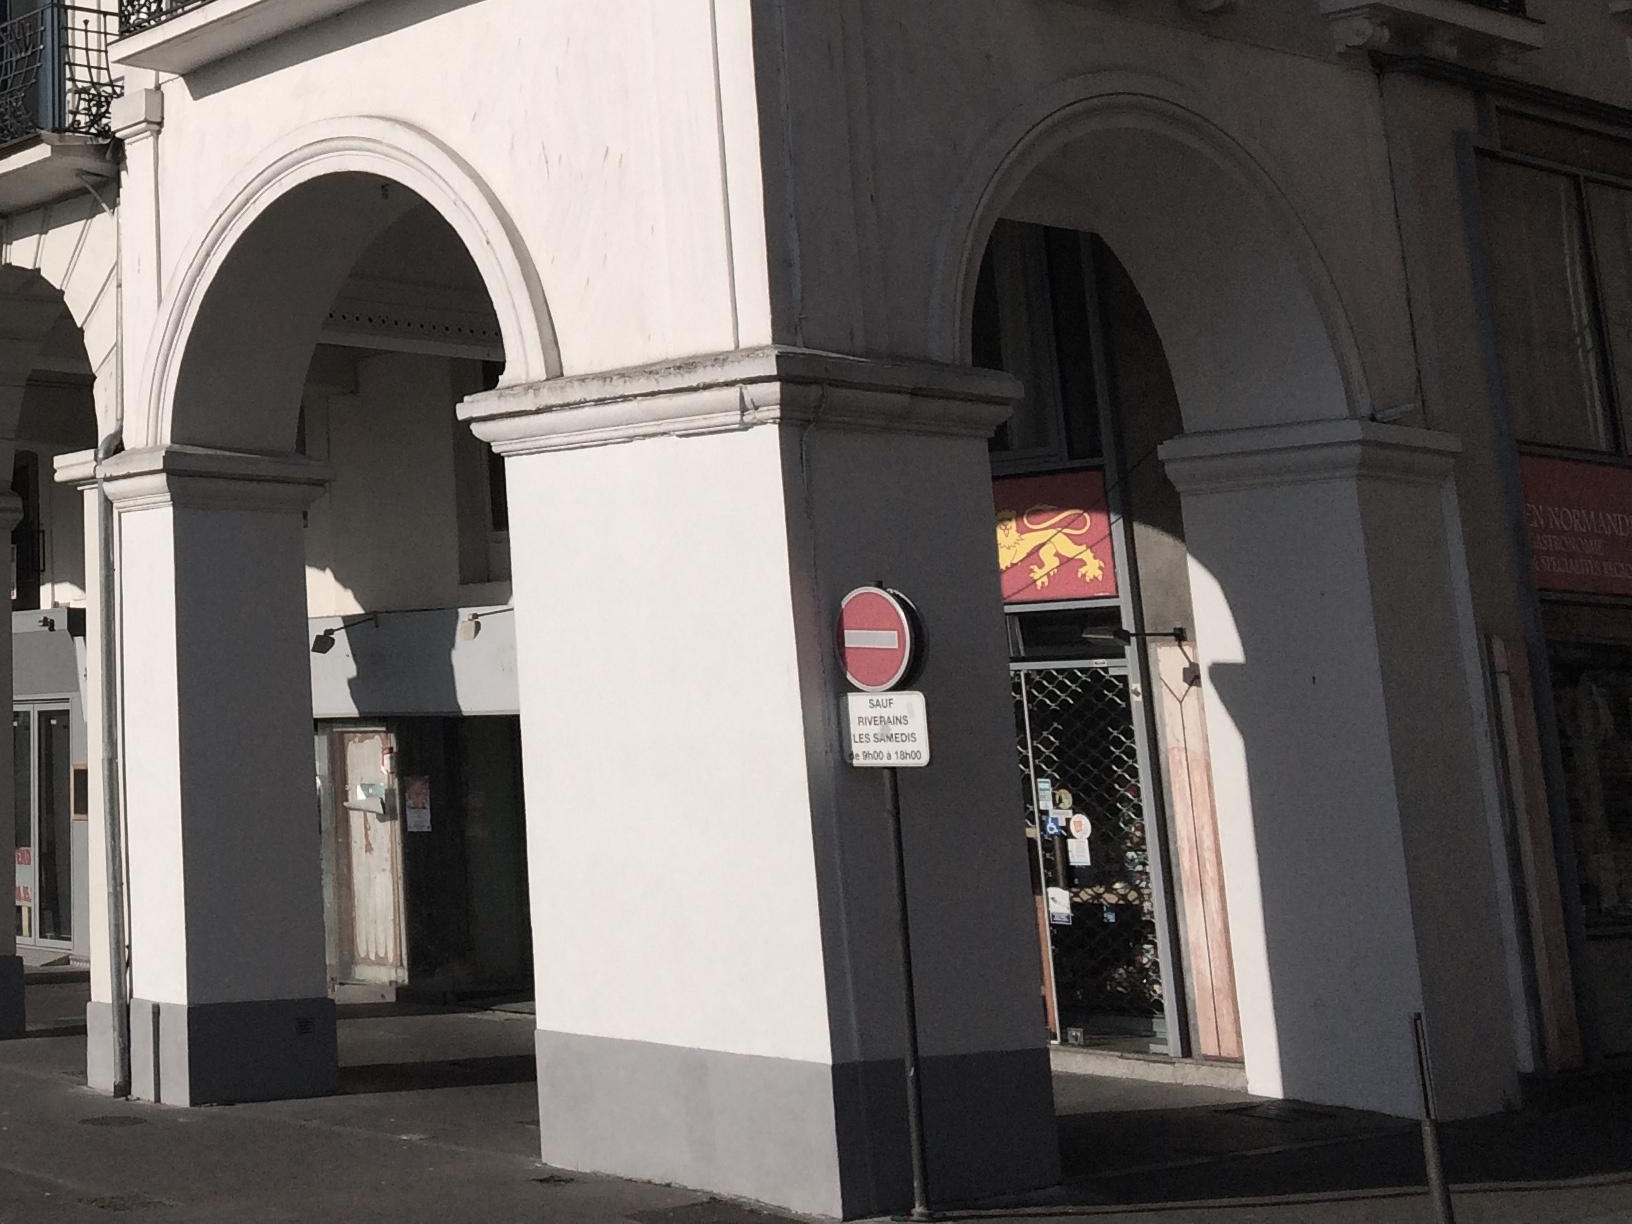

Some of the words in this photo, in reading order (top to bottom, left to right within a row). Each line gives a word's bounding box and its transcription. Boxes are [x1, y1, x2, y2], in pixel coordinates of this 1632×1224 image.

[868, 698, 894, 708] SAUF
[857, 715, 909, 726] RIVERAINS
[853, 733, 871, 743] LES
[872, 732, 917, 743] SAMEDIS
[849, 750, 860, 760] de
[862, 750, 884, 760] 9h00
[895, 750, 922, 760] 18h00
